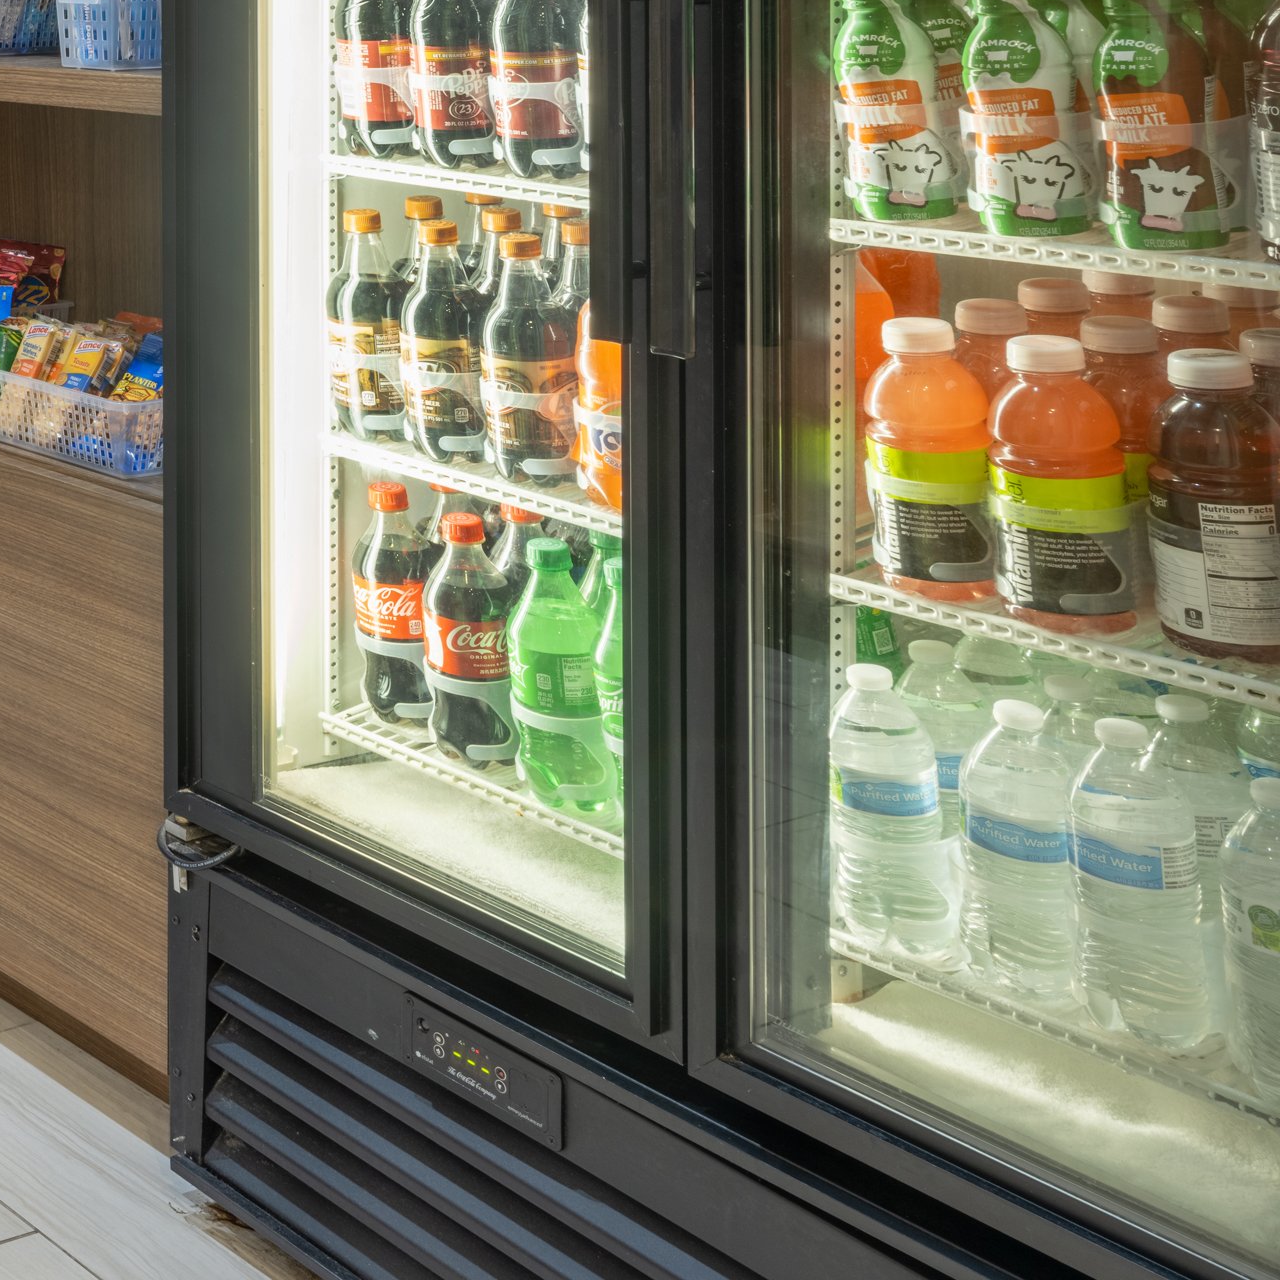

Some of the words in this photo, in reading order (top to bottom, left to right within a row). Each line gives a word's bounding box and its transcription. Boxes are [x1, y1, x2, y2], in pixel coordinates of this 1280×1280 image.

[463, 67, 483, 82] Dr
[892, 90, 908, 101] FAT
[460, 103, 471, 113] 23
[1021, 99, 1040, 111] FAT
[1143, 104, 1157, 114] FAT
[1258, 104, 1280, 116] zero
[1116, 129, 1150, 144] MILK
[28, 325, 49, 336] Lance
[78, 341, 102, 351] Lance
[123, 372, 158, 389] PLANTERS
[1200, 505, 1245, 514] Nutrition
[1248, 505, 1273, 514] Facts
[1202, 526, 1239, 535] Calories
[1269, 525, 1275, 535] 0
[581, 687, 593, 695] 230
[851, 787, 901, 803] Purified
[971, 820, 1021, 847] Purified
[1024, 837, 1061, 850] Water
[1111, 855, 1154, 874] Water
